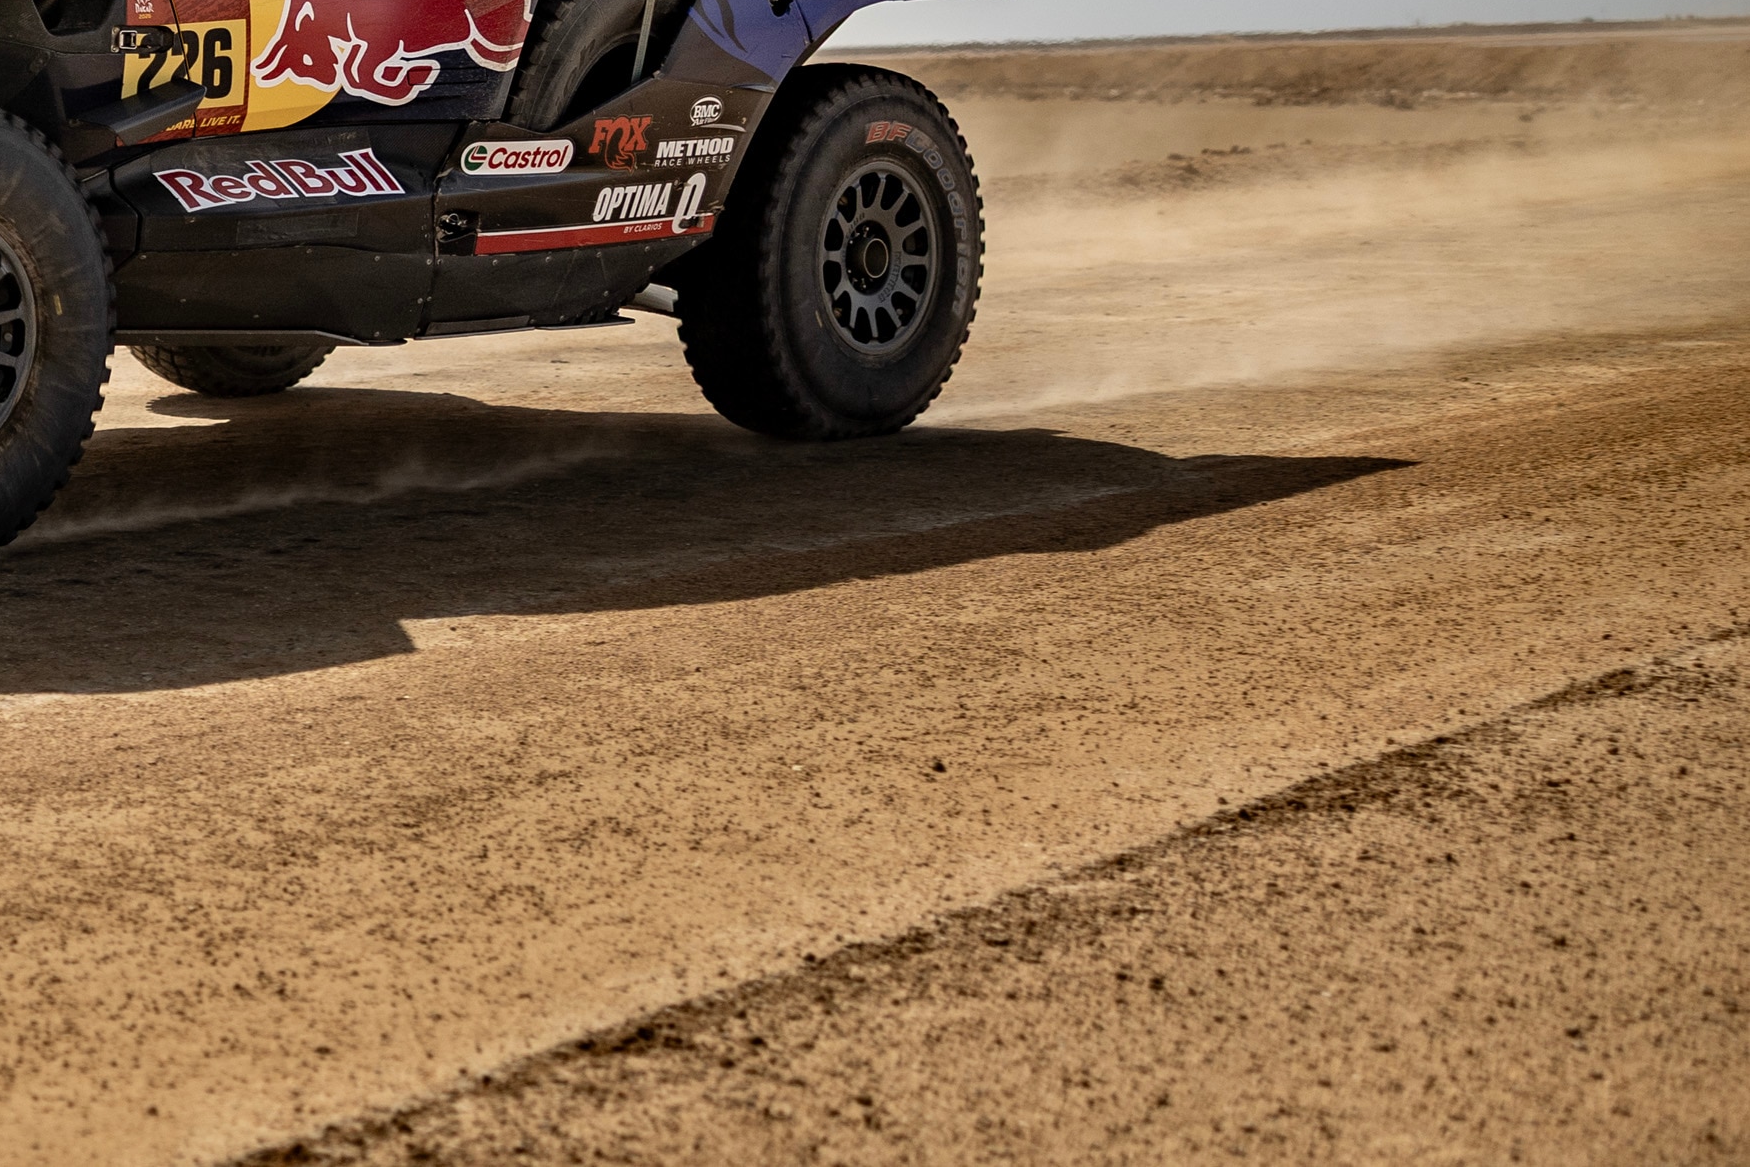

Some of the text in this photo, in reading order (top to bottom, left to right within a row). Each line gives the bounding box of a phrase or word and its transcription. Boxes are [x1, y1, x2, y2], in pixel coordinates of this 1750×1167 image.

[200, 116, 227, 127] LIVE
[225, 114, 242, 125] IT.
[693, 104, 720, 119] BMC
[588, 114, 652, 172] FOX
[656, 137, 735, 159] METHOD
[488, 145, 569, 170] Castrol
[654, 155, 731, 168] RACE WHEELS
[592, 182, 673, 222] OPTIMA
[623, 222, 663, 234] BY CLARIOS
